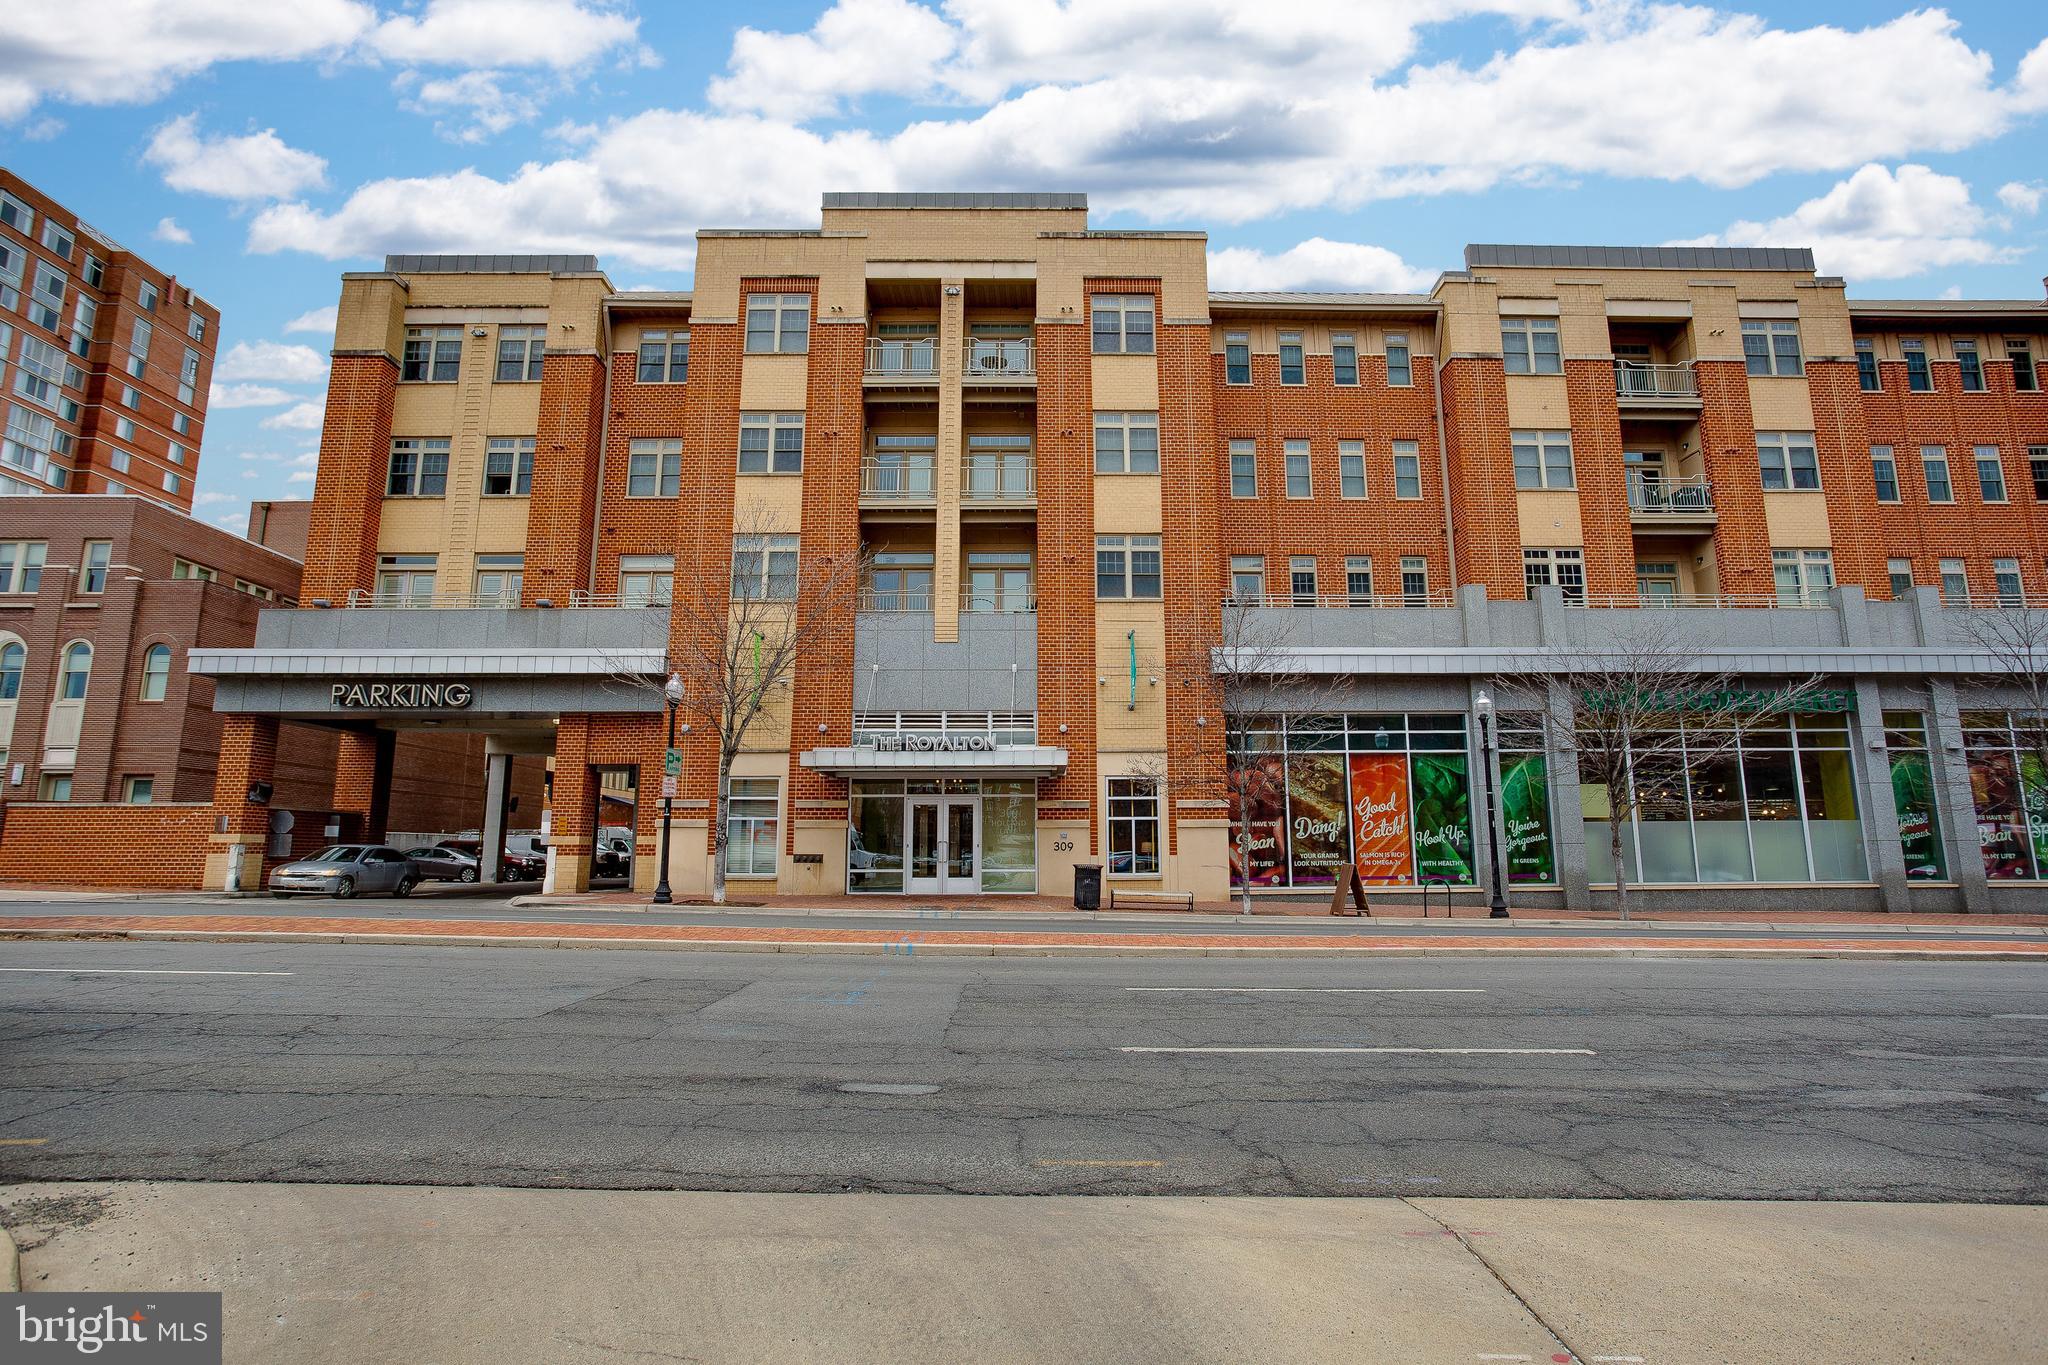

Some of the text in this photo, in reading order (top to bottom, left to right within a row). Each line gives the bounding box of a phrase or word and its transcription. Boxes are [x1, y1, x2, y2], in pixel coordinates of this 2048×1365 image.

[330, 683, 471, 707] PARKING
[870, 732, 997, 751] THE ROYALTON
[1355, 791, 1398, 821] Good
[1294, 811, 1343, 842] Dang!
[1360, 814, 1406, 842] Catch!
[1416, 824, 1467, 847] Hook Up
[1508, 816, 1540, 837] You're
[1977, 825, 2014, 847] Bean
[1053, 841, 1074, 852] 309
[1437, 859, 1464, 867] HEALTHY
